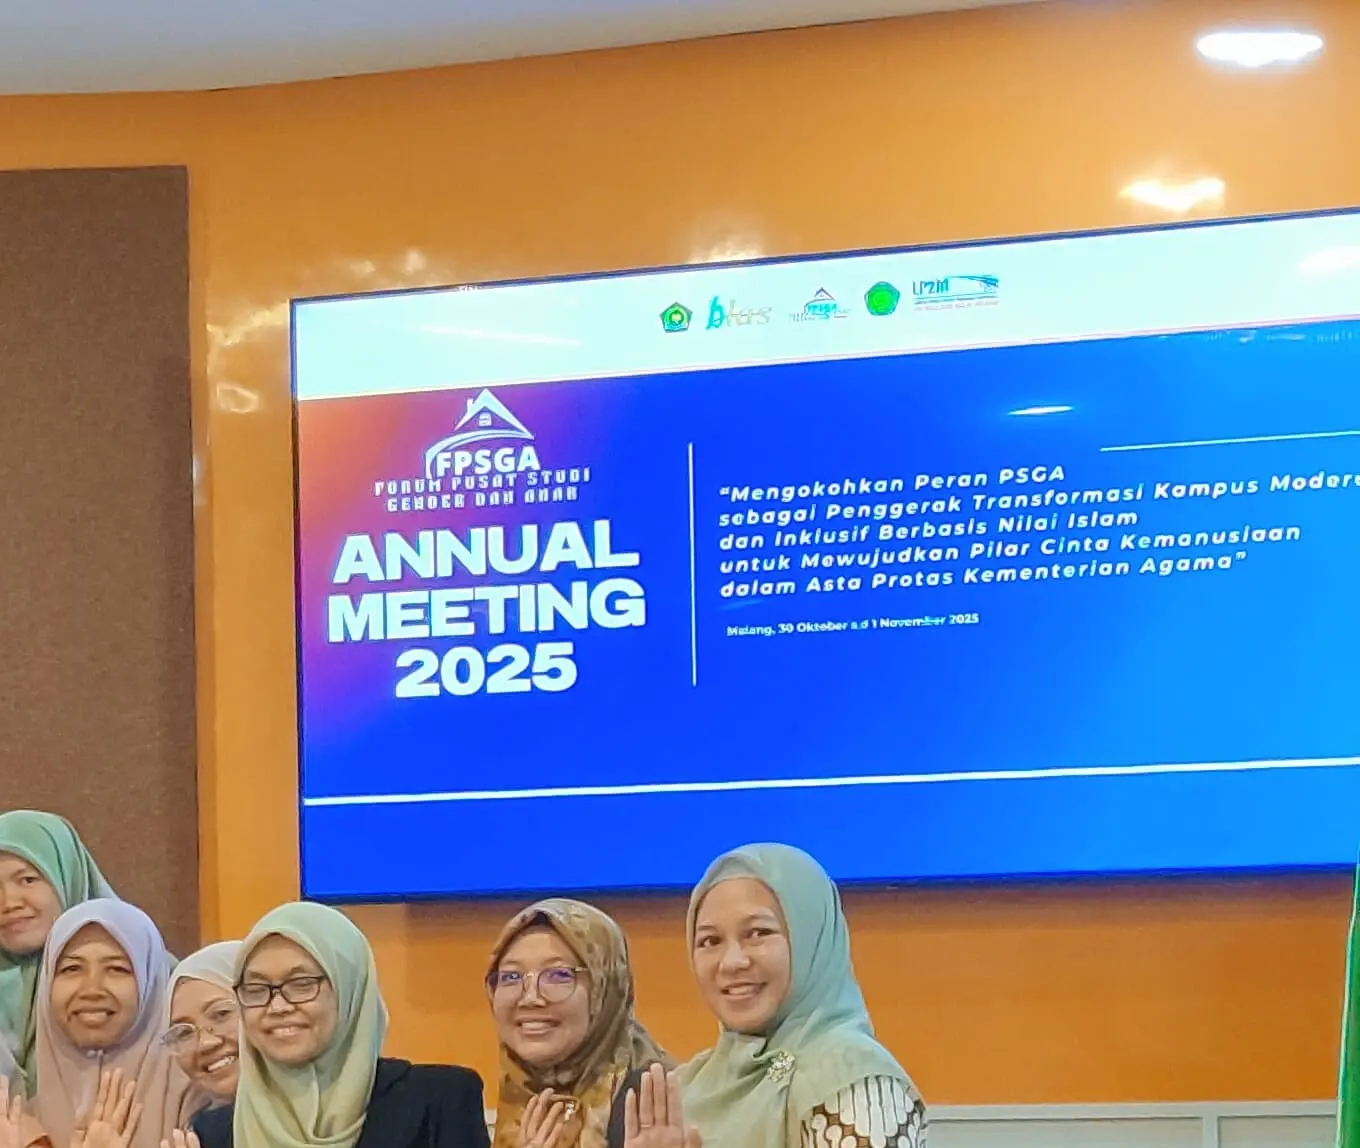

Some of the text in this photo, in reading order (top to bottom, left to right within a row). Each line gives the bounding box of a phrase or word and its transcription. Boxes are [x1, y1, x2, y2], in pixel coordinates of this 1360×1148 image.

[374, 467, 591, 496] FORUM PUSAT STUDI
[435, 446, 541, 478] FPSGA
[914, 472, 988, 490] Peran
[999, 465, 1065, 484] PSGA
[719, 504, 816, 527] sebagai
[826, 496, 962, 520] Penggerak
[972, 482, 1143, 511] Transformasi
[1154, 479, 1259, 499] Kampus
[719, 510, 1138, 551] dan Inklusif Berbasis Nilai Islam
[720, 524, 1301, 574] untuk Mewujudkan Pilar Cinta Kemanusiaan
[332, 519, 640, 584] ANNUAL
[720, 578, 796, 598] dalam
[806, 574, 862, 593] Asta
[871, 569, 954, 589] Protas
[963, 558, 1130, 584] Kementerian
[327, 578, 646, 644] MEETING
[778, 623, 794, 634] 30
[796, 619, 848, 632] Oktober
[880, 615, 946, 629] November
[949, 612, 979, 625] 2025
[395, 641, 578, 698] 2025
